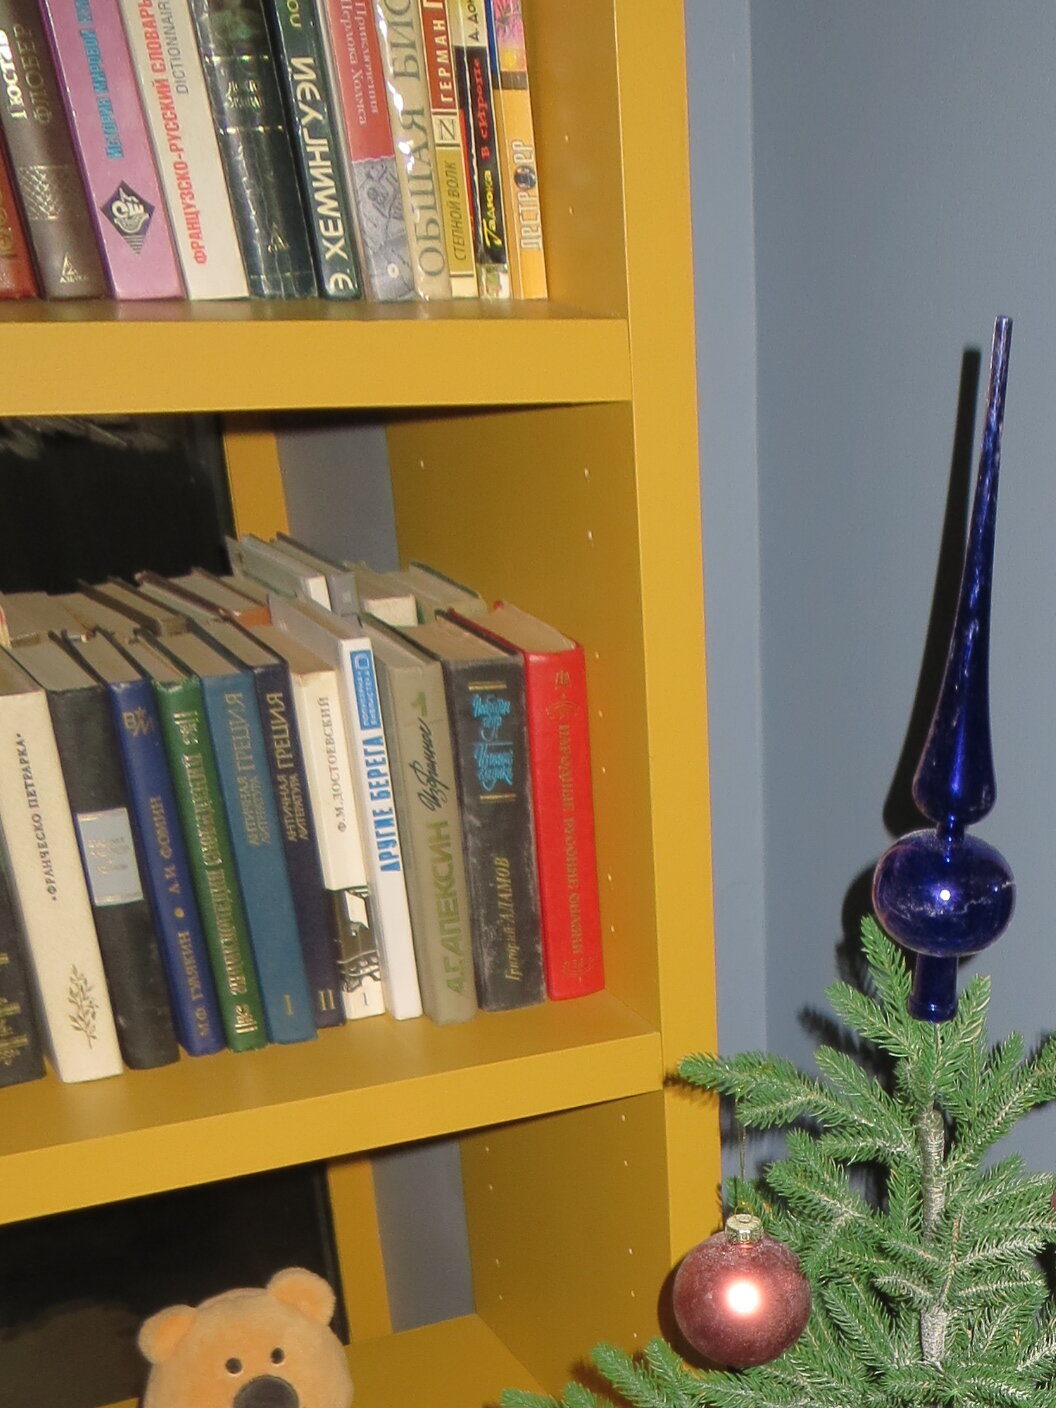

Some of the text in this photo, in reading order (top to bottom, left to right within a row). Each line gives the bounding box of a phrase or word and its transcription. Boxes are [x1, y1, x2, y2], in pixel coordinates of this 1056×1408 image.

[156, 0, 189, 95] DICTIONNAIR
[433, 19, 458, 104] ГЕРМАН
[151, 81, 207, 265] ФРАНЦУЗСКО-РУССКИЙ
[290, 56, 349, 261] ХЕМИНГУЭЙ
[443, 160, 467, 262] СТЕПНОЙ ВОЛК
[482, 169, 504, 248] Гадюка
[224, 692, 256, 771] ГРЕЦИЯ
[266, 692, 294, 771] ГРЕЦИЯ
[276, 773, 298, 842] АНТИЧНАЯ
[289, 773, 309, 841] ЛИТЕРАТУРА
[361, 735, 401, 872] ДРУГИЕ БЕРЕГА
